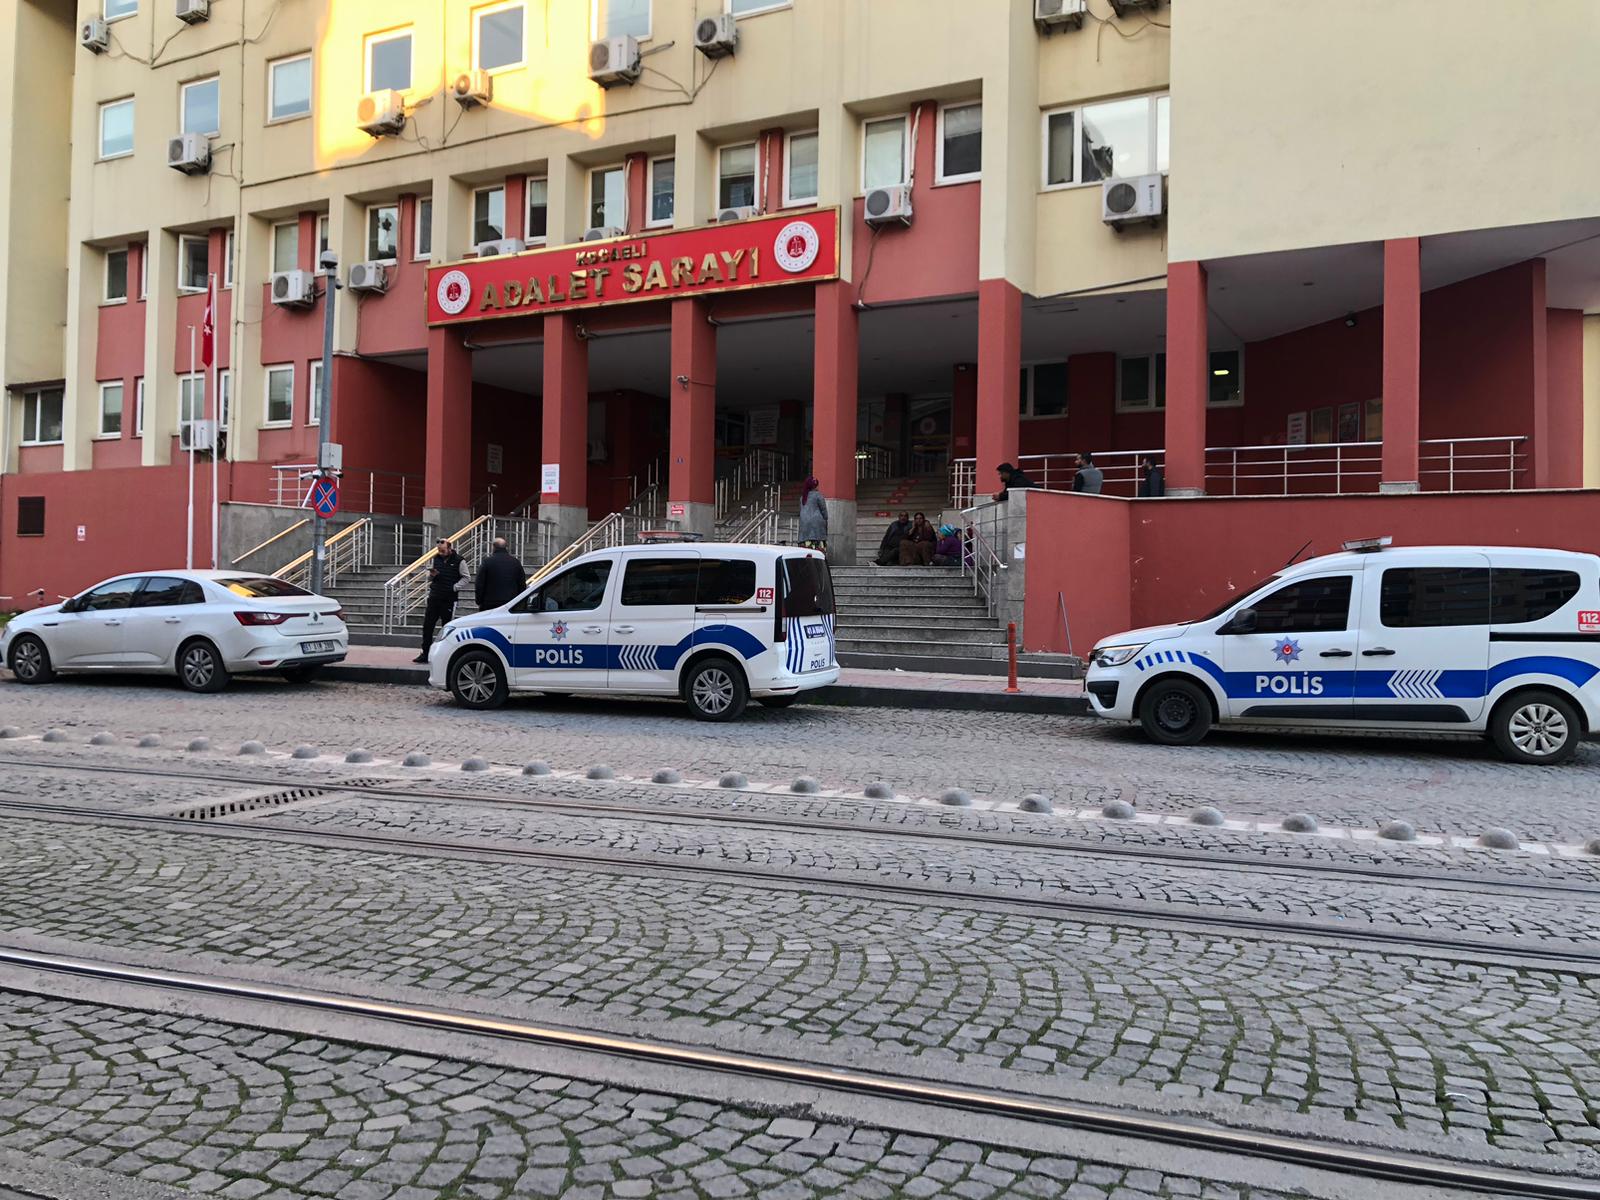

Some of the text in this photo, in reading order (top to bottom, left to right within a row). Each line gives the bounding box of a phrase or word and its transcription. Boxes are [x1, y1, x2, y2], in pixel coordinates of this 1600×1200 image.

[479, 247, 759, 310] ADALET SARAYI
[759, 589, 772, 598] 112
[1580, 612, 1600, 624] 112
[535, 645, 584, 664] POLİS
[1255, 671, 1324, 695] POLİS
